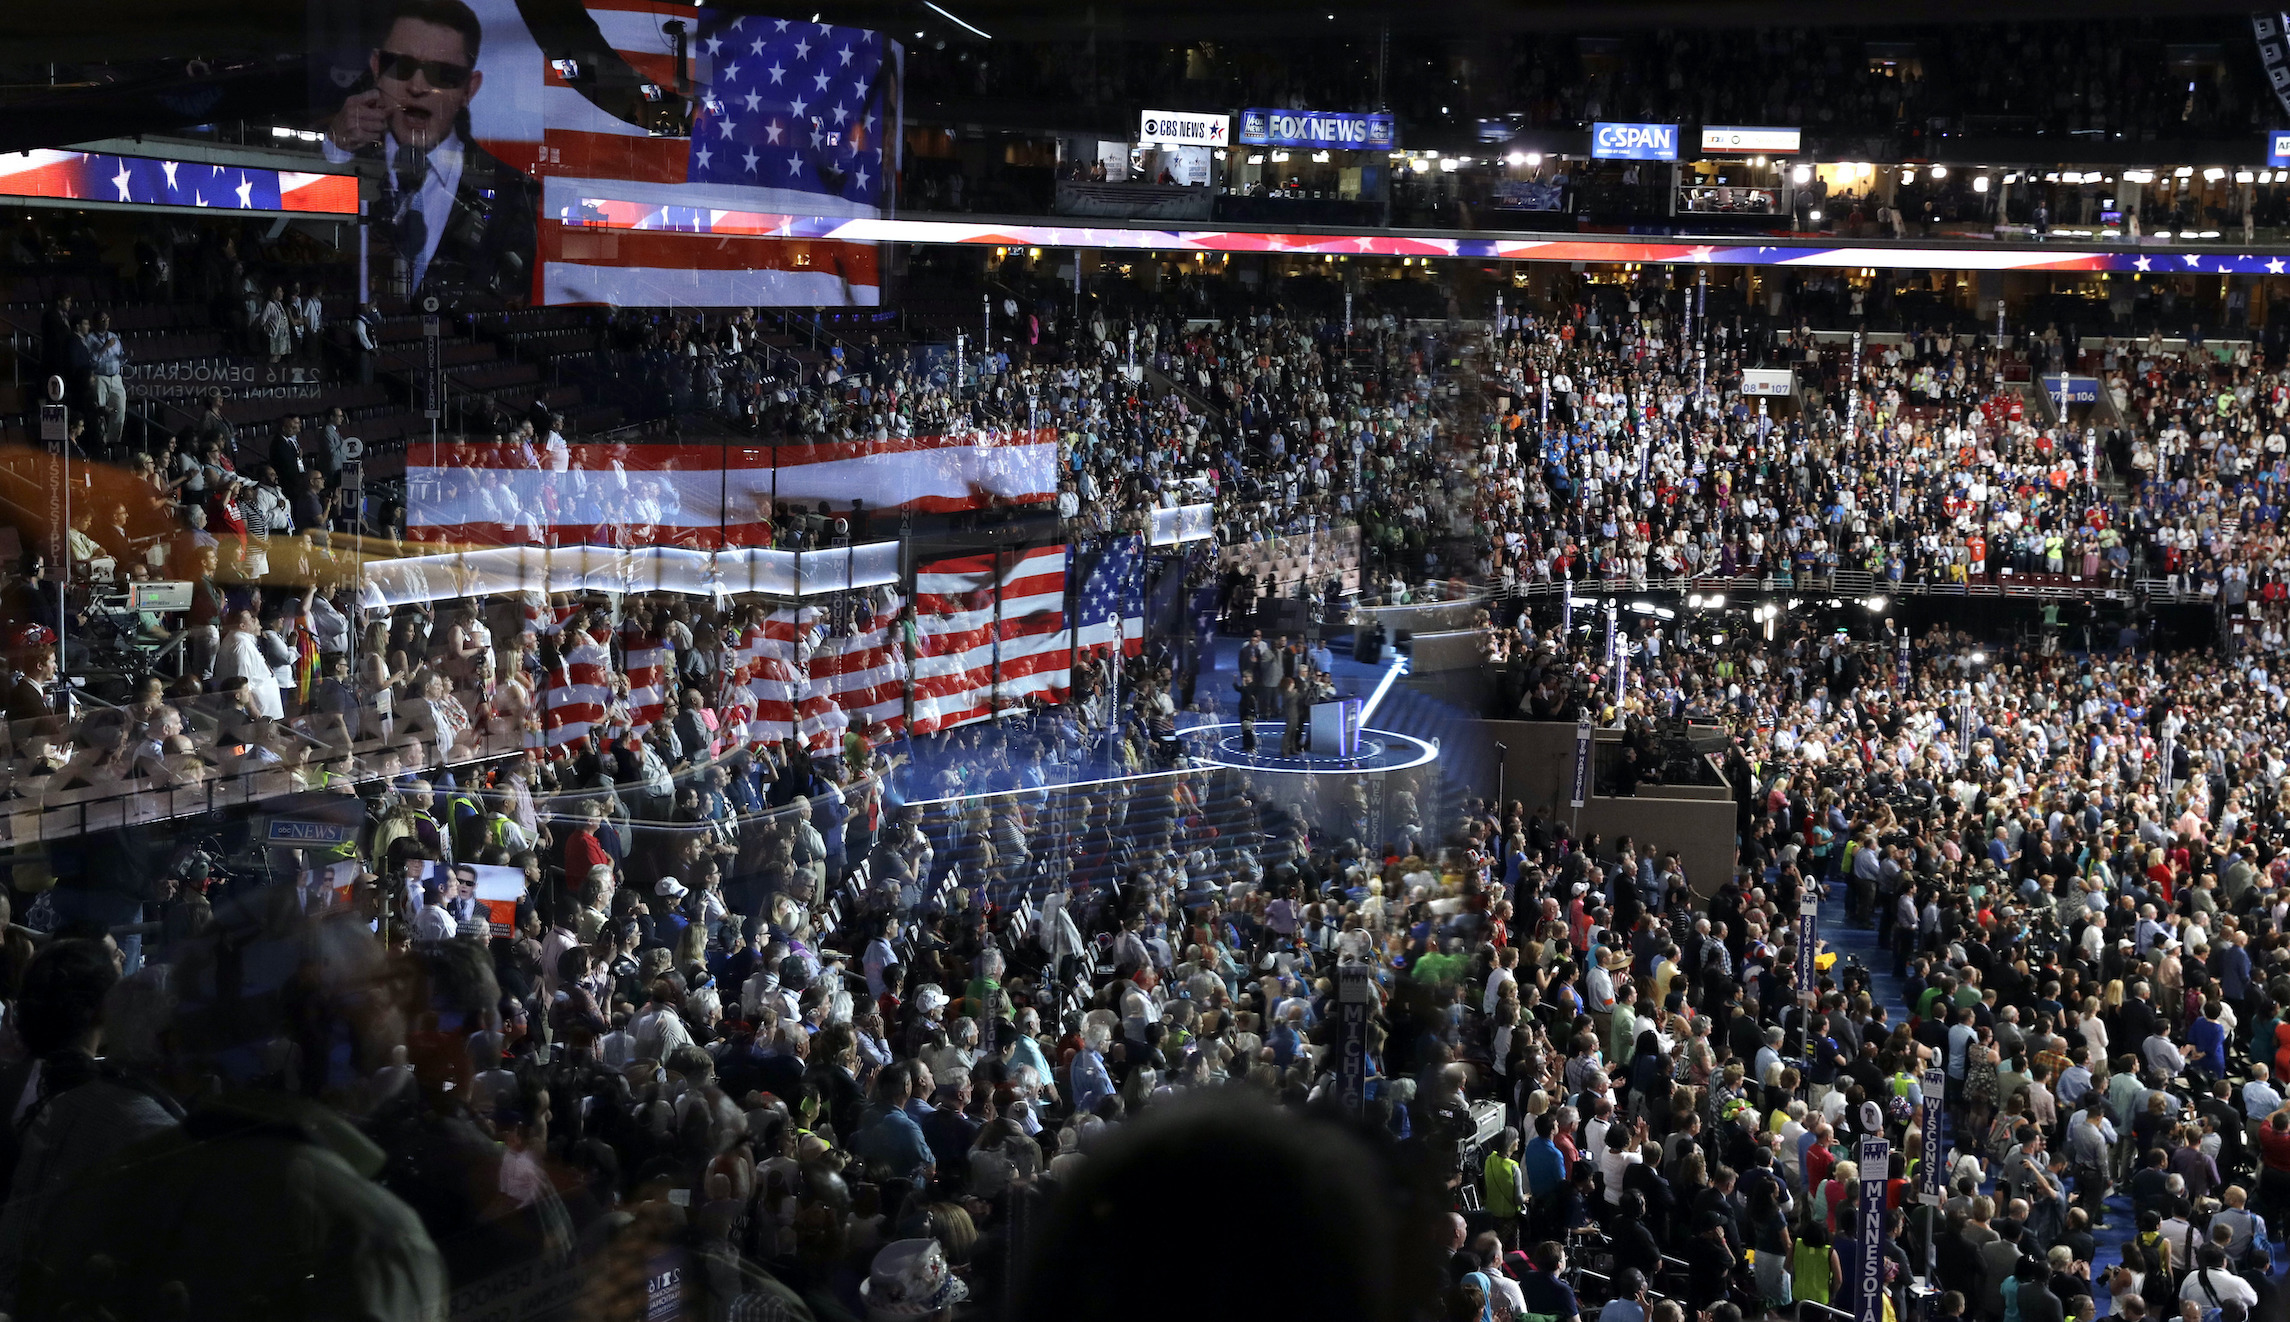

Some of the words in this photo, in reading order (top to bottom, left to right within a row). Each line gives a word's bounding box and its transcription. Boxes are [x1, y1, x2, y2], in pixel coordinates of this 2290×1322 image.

[1160, 119, 1177, 137] CBS
[1180, 121, 1205, 139] NEWS
[1269, 115, 1308, 139] FOX
[1310, 118, 1366, 142] NEWS
[1598, 127, 1672, 148] C-SPAN
[427, 335, 435, 369] RHODE
[427, 371, 435, 410] ISLAND
[1743, 383, 1757, 393] 08
[1772, 384, 1788, 394] 107
[2077, 391, 2096, 401] 106
[47, 441, 61, 567] MISSISSIPPI
[901, 468, 911, 529] ARIZONA
[341, 489, 357, 592] UTAH
[834, 559, 844, 638] MISSOURI
[1579, 739, 1587, 754] NEW
[1371, 780, 1381, 805] NEW
[1575, 756, 1585, 800] HAMPSHIRE
[291, 823, 337, 840] NEWS
[1369, 810, 1380, 859] MEXICO
[1427, 776, 1439, 850] HAWAII
[1050, 793, 1064, 894] INDIANA
[1802, 947, 1810, 991] CAROLINA
[1341, 1004, 1363, 1109] MICHIG
[1923, 1096, 1941, 1195] WISCONSIN
[1862, 1181, 1883, 1322] MINNESOTA
